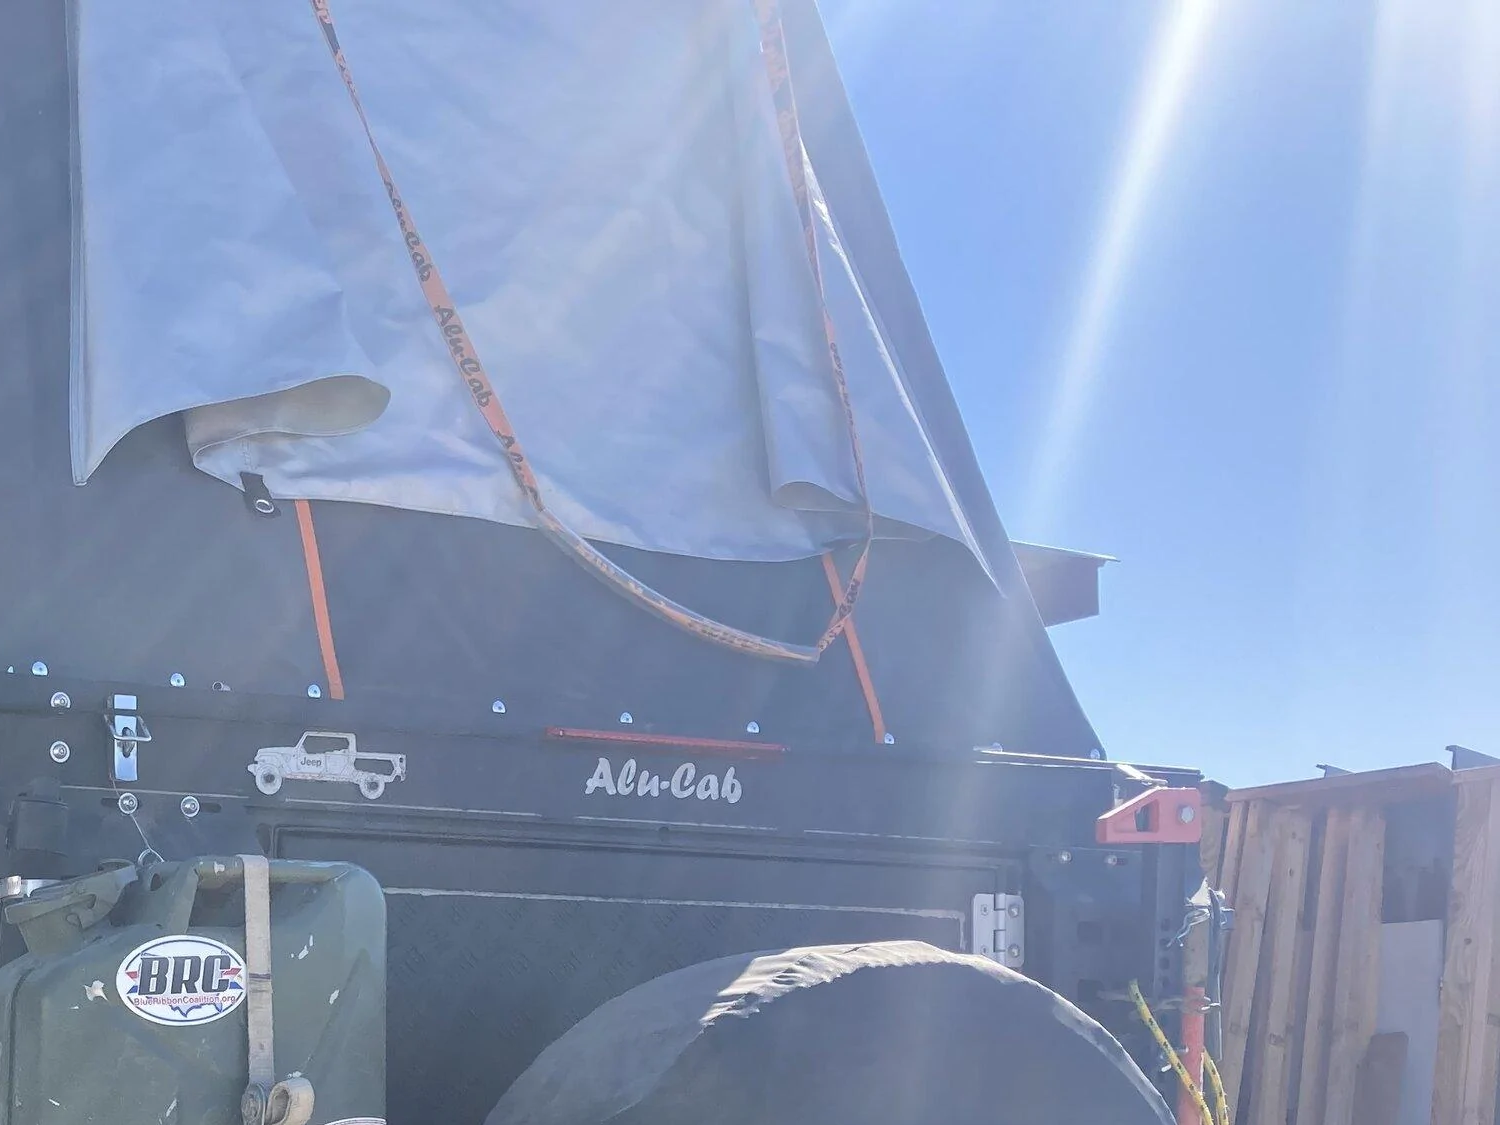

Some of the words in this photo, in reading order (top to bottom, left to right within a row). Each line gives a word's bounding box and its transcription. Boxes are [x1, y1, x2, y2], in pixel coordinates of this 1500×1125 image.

[435, 305, 492, 408] Alu-Cab
[300, 757, 322, 767] Jeep
[585, 757, 742, 804] Alu-Cab
[138, 955, 231, 995] BRC
[134, 995, 236, 1006] BlueRibbonCoalition.org
